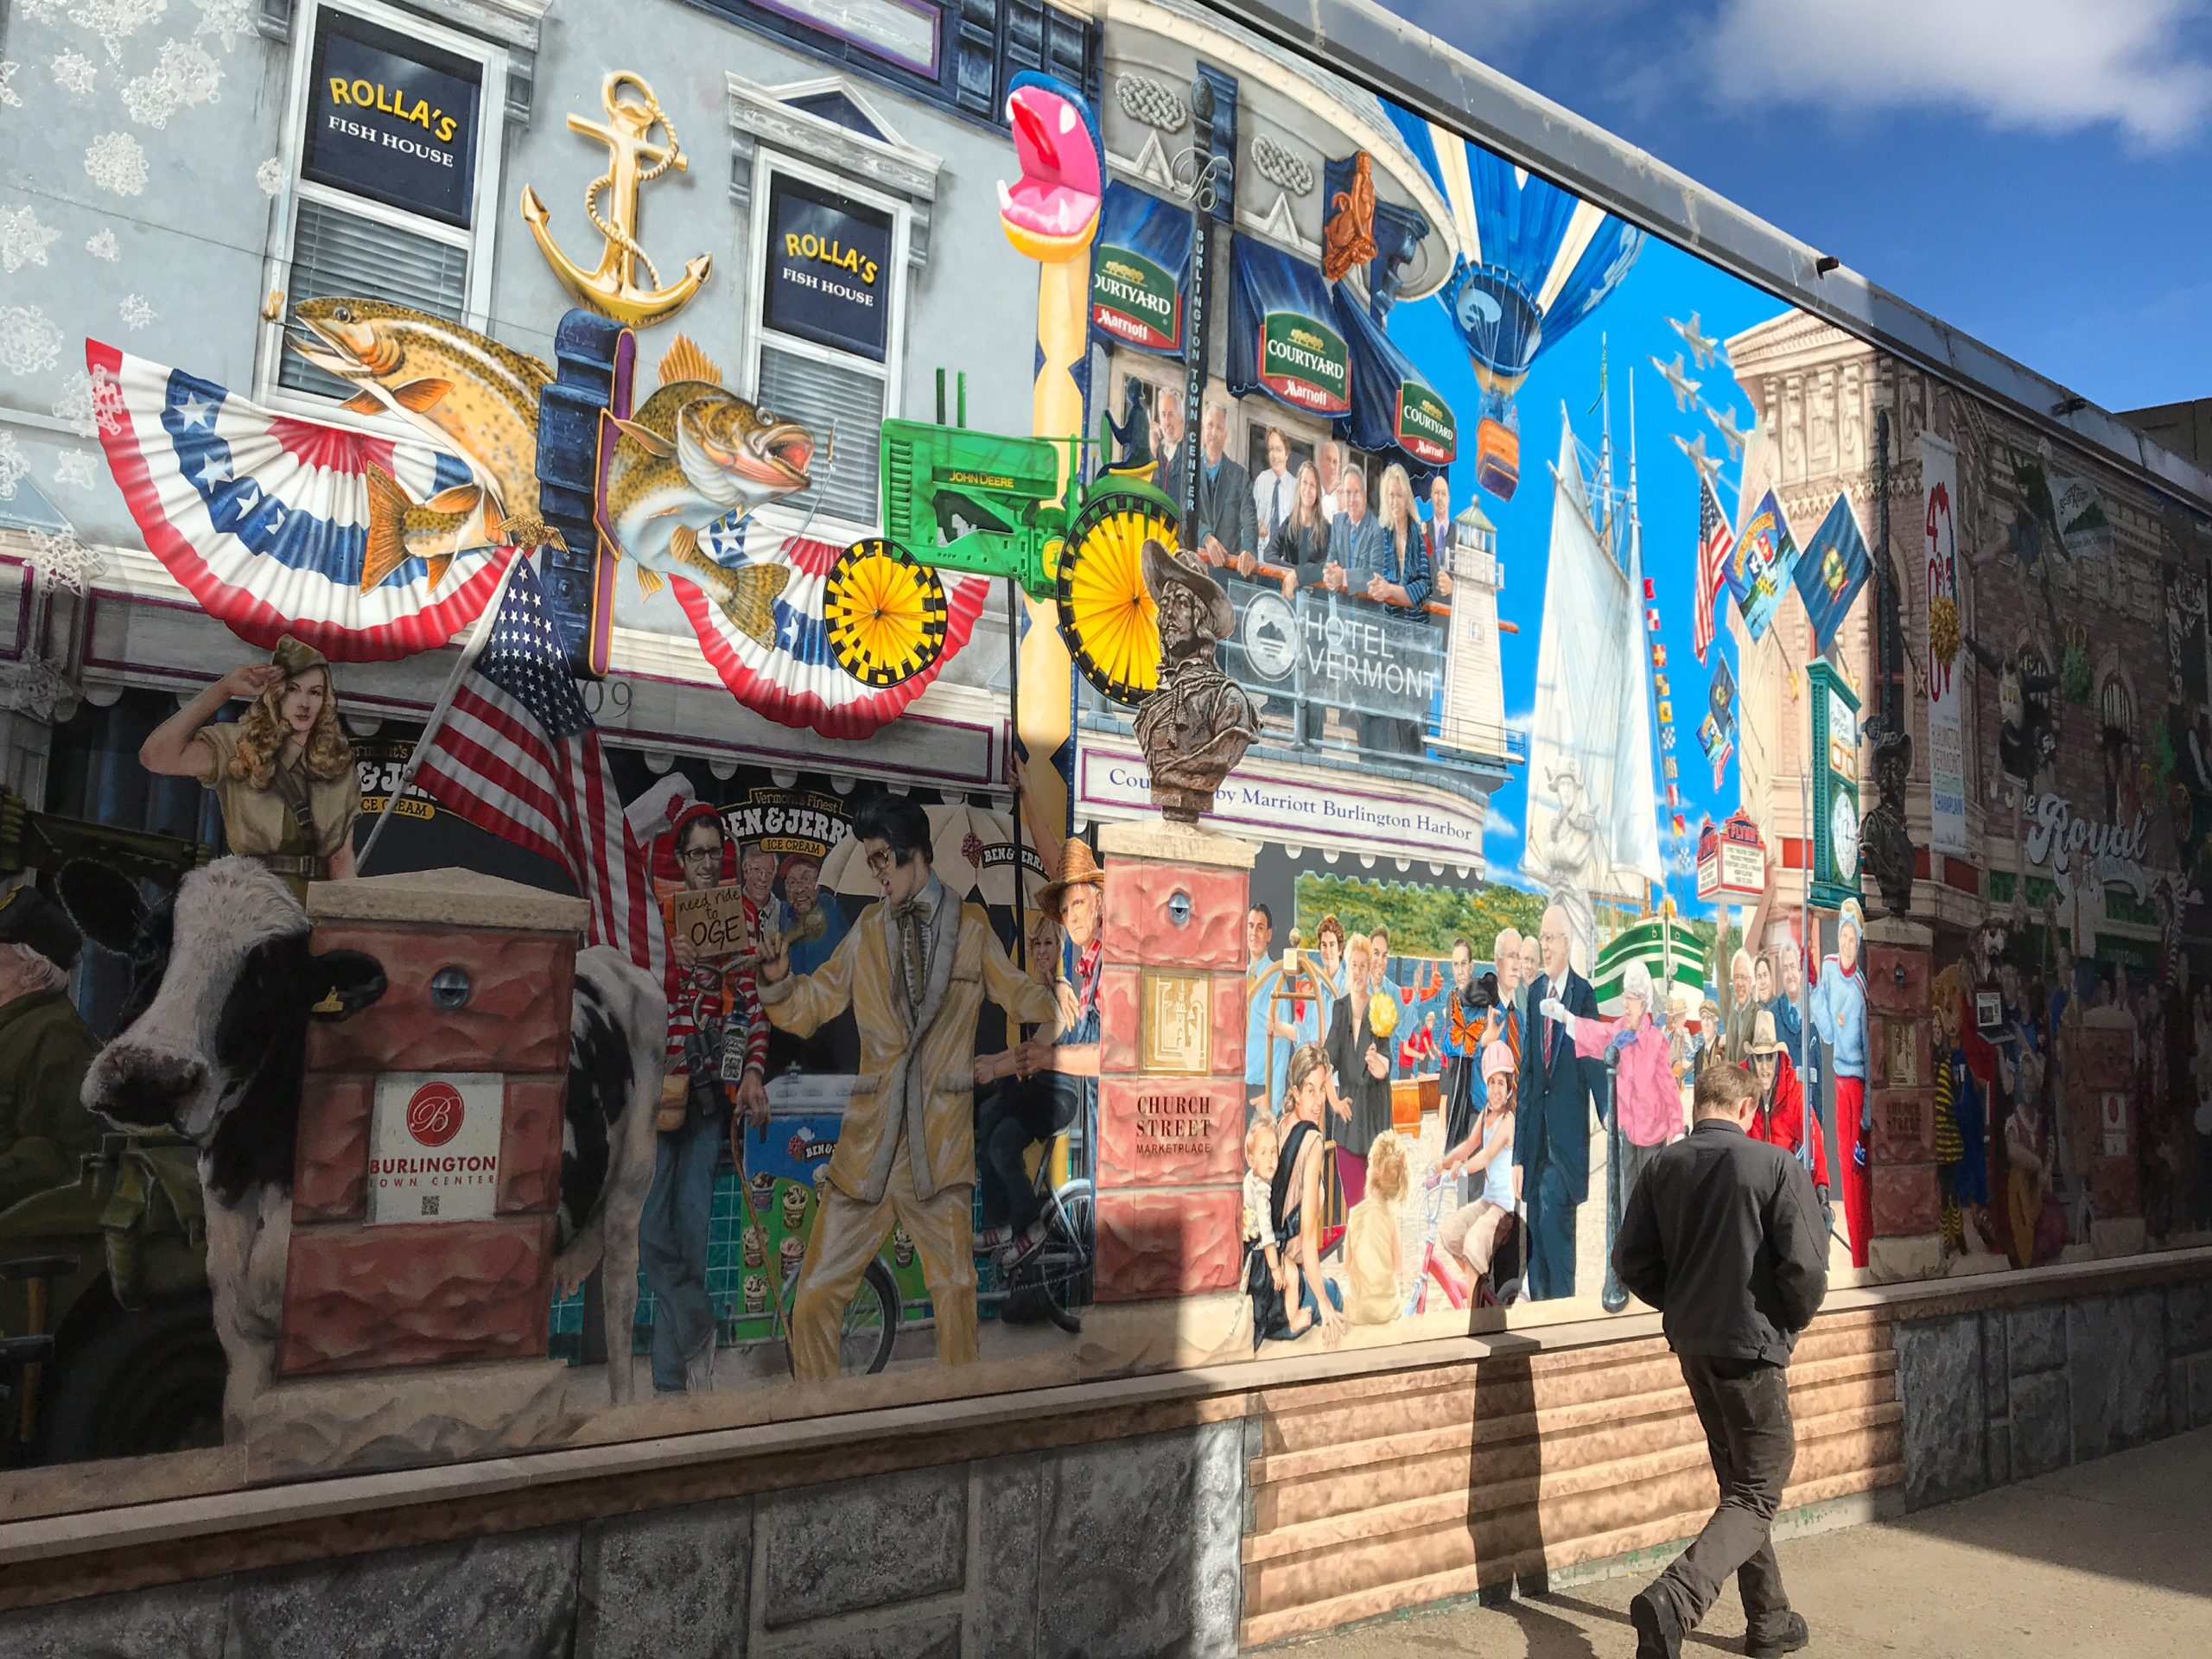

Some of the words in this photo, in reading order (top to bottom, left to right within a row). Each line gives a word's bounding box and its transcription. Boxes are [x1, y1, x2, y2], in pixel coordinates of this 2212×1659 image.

[328, 77, 458, 143] ROLLA'S
[328, 115, 377, 143] FISH
[381, 134, 454, 168] HOUSE
[785, 232, 879, 284] ROLLA'S
[782, 267, 818, 289] FISH
[821, 281, 874, 307] HOUSE
[1191, 229, 1204, 361] BURLINGTON
[1097, 308, 1148, 340] Marriott
[1268, 338, 1344, 380] COURTYARD
[1188, 369, 1199, 421] TOWN
[1283, 379, 1327, 406] Marriott
[1403, 404, 1453, 442] COURTYARD
[1415, 440, 1444, 459] Marriott
[949, 469, 978, 484] JOHN
[979, 473, 1014, 488] DEERE
[1186, 432, 1197, 512] CENTER
[1305, 609, 1395, 658] HOTEL
[1306, 644, 1440, 700] VERMONT
[807, 794, 840, 813] Finest
[1242, 789, 1317, 813] Marriott
[1323, 800, 1412, 830] Burlington
[1417, 815, 1472, 841] Harbor
[766, 839, 784, 850] ICE
[785, 840, 821, 855] CREAM
[678, 893, 711, 912] need
[714, 887, 741, 906] ride
[706, 907, 718, 920] to
[690, 915, 741, 950] OGE
[1136, 1096, 1211, 1115] CHURCH
[1136, 1119, 1211, 1137] STREET
[369, 1155, 497, 1175] BURLINGTON
[1136, 1143, 1211, 1154] MARKETPLACE
[369, 1177, 419, 1188] TOWN
[432, 1175, 495, 1187] CENTER
